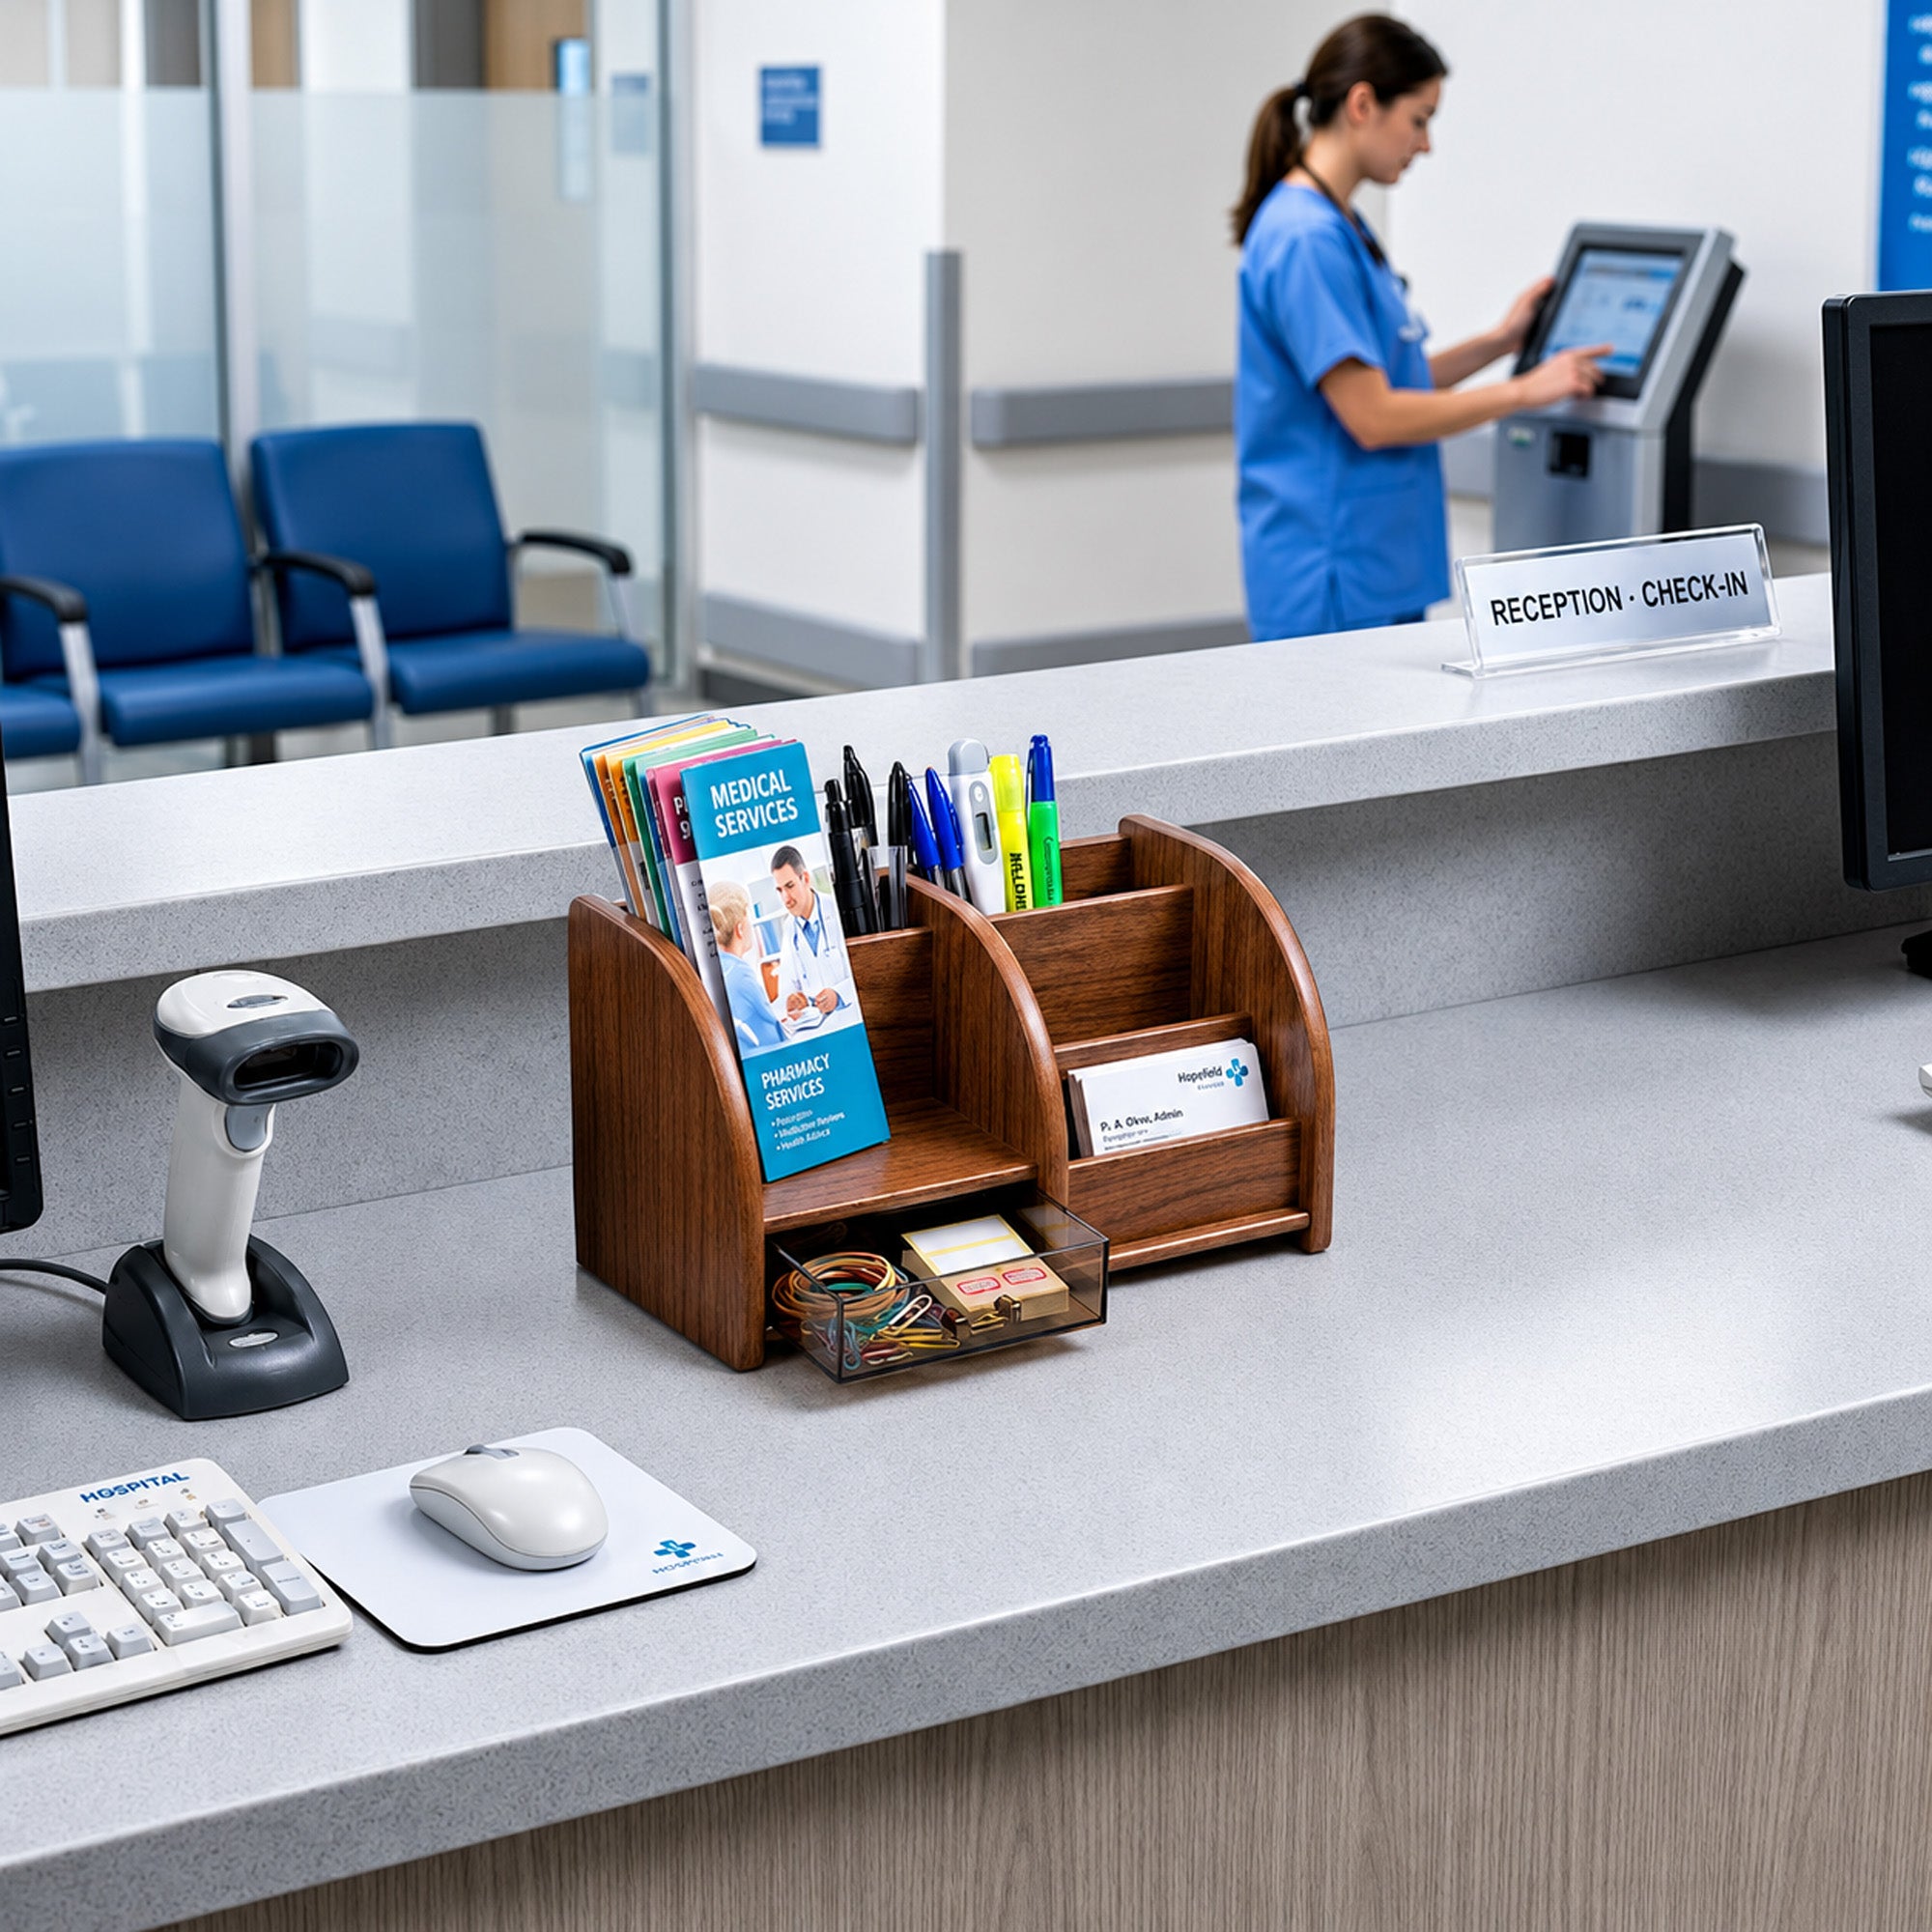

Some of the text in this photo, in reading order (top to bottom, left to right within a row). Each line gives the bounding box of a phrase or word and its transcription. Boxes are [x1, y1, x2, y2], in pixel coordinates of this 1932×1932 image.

[1490, 571, 1748, 626] RECEPTION CHECK-IN
[710, 769, 792, 810] MEDICAL
[715, 797, 799, 838] SERVICES
[761, 1053, 830, 1089] PHARMACY
[765, 1077, 825, 1110] SERVICES
[80, 1472, 190, 1503] HOSPITAL
